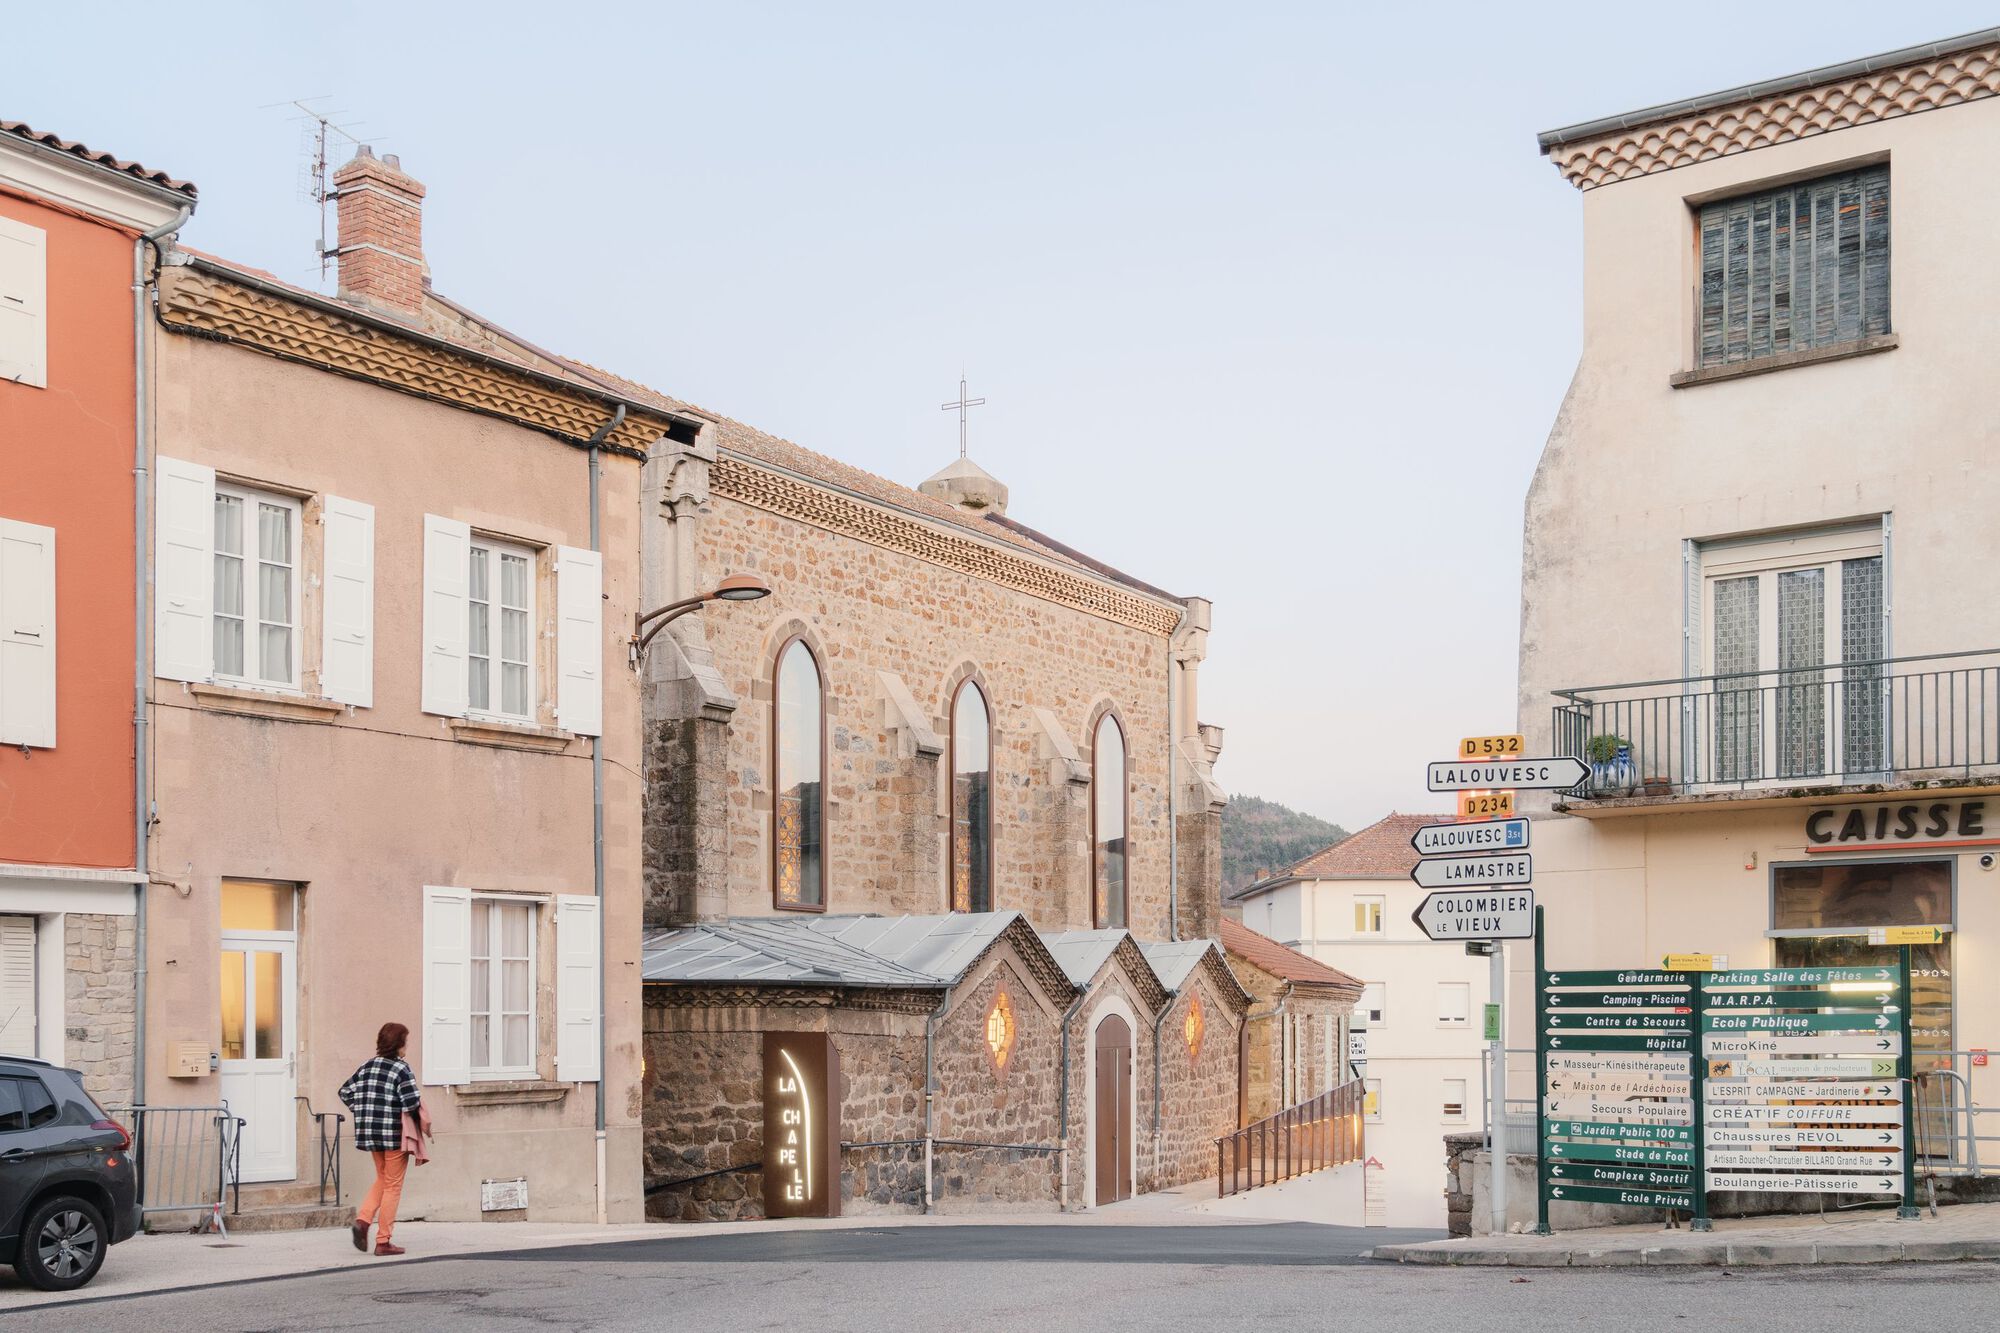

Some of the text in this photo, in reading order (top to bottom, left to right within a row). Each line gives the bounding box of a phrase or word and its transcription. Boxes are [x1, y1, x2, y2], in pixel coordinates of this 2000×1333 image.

[1466, 738, 1519, 754] D 532
[1435, 767, 1549, 783] LALOUVESC
[1468, 797, 1508, 814] D 234
[1805, 802, 1984, 844] CAISSE
[1425, 829, 1501, 847] LALOUVESC
[1446, 862, 1525, 879] LAMASTRE
[1437, 897, 1527, 913] COLOMBIER
[1437, 917, 1501, 932] LE VIEUX
[1617, 972, 1685, 983] Gendarmerie
[1710, 970, 1862, 984] Parking Salle des Fêtes
[1602, 994, 1643, 1006] Camping
[1651, 994, 1686, 1004] Piscine
[1711, 995, 1777, 1006] M.A.R.P.A.
[1585, 1016, 1686, 1027] Centre de Secours
[1712, 1017, 1809, 1029] Ecole Publique
[1646, 1038, 1687, 1049] Hôpital
[1712, 1041, 1777, 1051] MicroKiné
[1564, 1060, 1686, 1071] Masseur-Kinésithérapeute
[779, 1077, 797, 1093] LA
[1572, 1082, 1606, 1091] Maison
[1610, 1083, 1621, 1092] de
[1712, 1087, 1751, 1096] L'ESPRIT
[1756, 1087, 1805, 1096] CAMPAGNE
[1815, 1086, 1860, 1096] Jardinerie
[1591, 1104, 1687, 1116] Secours Populaire
[1712, 1107, 1852, 1119] CRÉAT'IF COIFFURE
[1584, 1125, 1616, 1136] Jardin
[1619, 1127, 1652, 1138] Public
[1655, 1128, 1675, 1139] 100
[1713, 1131, 1843, 1142] Chaussures REVOL
[1615, 1148, 1688, 1162] Stade de Foot
[1714, 1155, 1873, 1166] Artisan Boucher-Charcutier BILLARD Grand Rue
[1594, 1168, 1689, 1184] Complexe Sportif
[1714, 1177, 1858, 1190] Boulangerie-Pâtisserie
[1621, 1192, 1690, 1206] Ecole Privée
